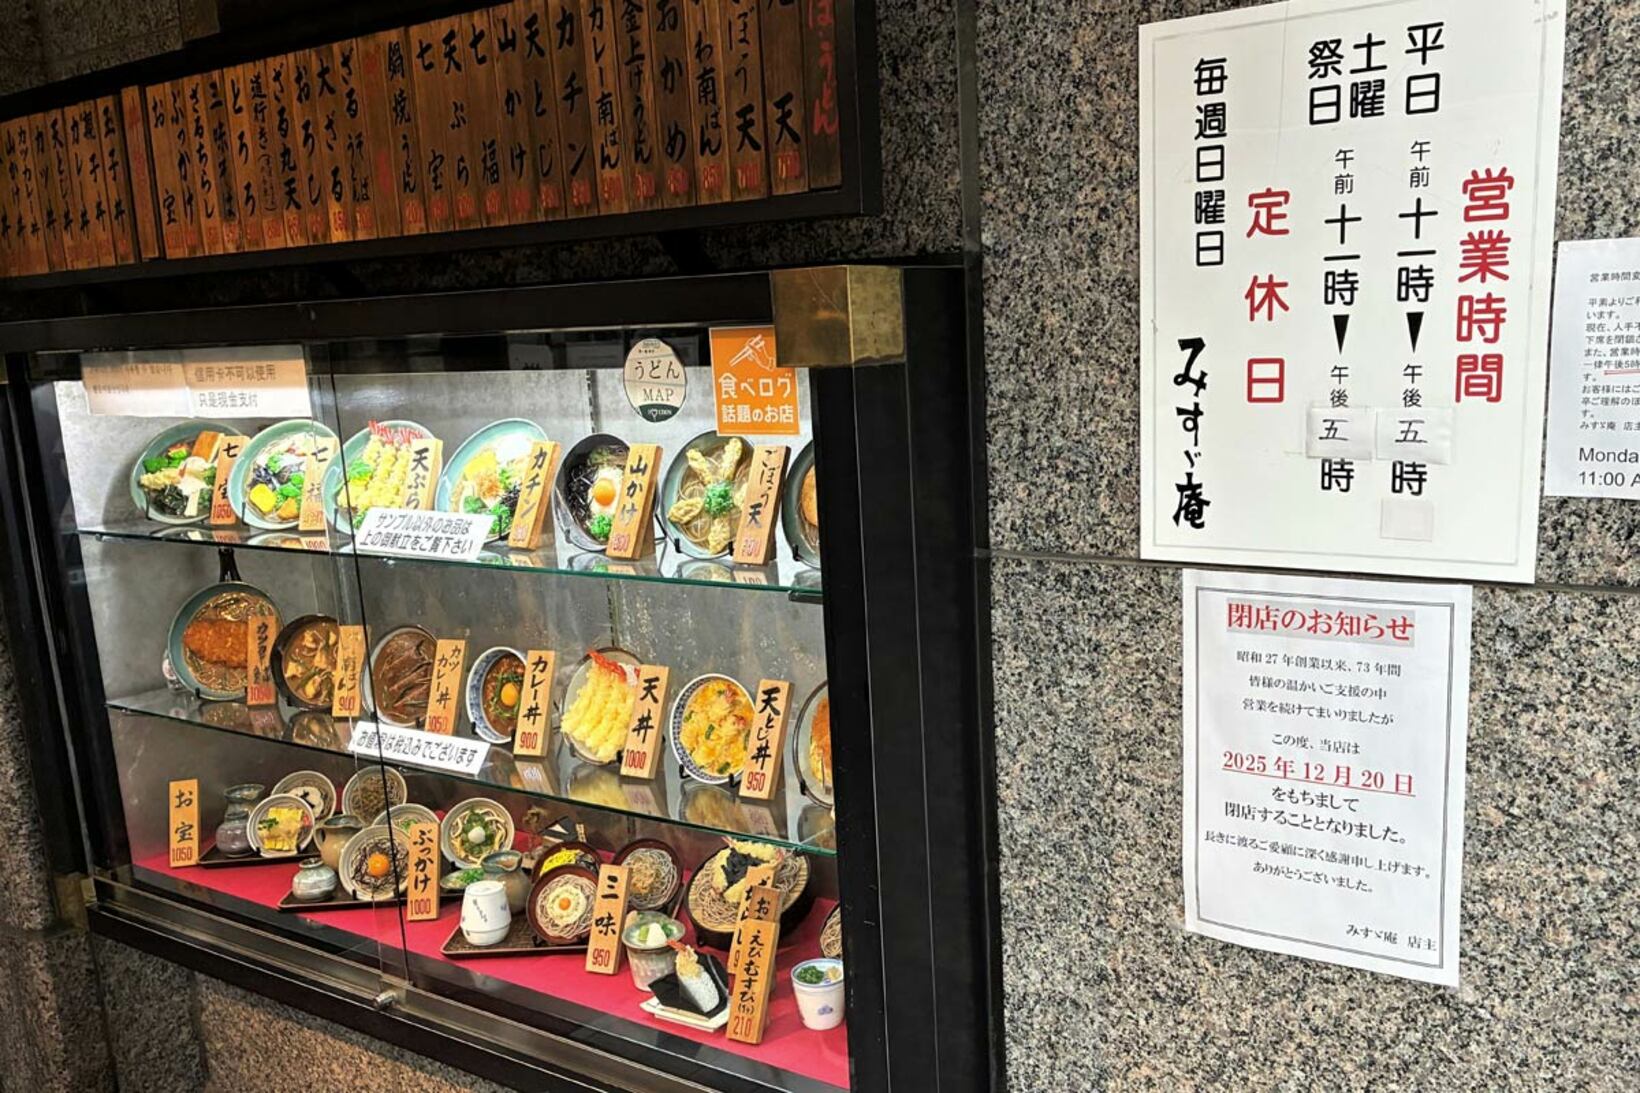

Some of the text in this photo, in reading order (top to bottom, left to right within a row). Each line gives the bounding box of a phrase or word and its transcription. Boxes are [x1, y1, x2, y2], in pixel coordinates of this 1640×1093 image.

[498, 18, 526, 180] 山かけ
[524, 13, 554, 178] 天とじ
[556, 6, 588, 177] カチン
[656, 0, 687, 163] おかめ
[729, 0, 762, 153] ぼう天
[1350, 32, 1388, 119] 土曜
[294, 65, 322, 206] おろし
[316, 58, 344, 203] 大ざる
[1193, 57, 1229, 267] 毎週日曜日
[1308, 38, 1362, 493] 祭日 午前十一時 午後五時
[1391, 21, 1446, 497] 平日 午前十一時 午後五時
[1455, 166, 1515, 403] 営業時間
[1246, 187, 1291, 403] 定休日
[634, 360, 681, 381] うどん
[643, 387, 675, 403] MAP
[718, 371, 794, 401] 食べログ
[721, 404, 795, 429] 話題のお店
[1172, 336, 1212, 530] みすゞ庵
[405, 447, 431, 511] 天ぷら
[520, 447, 548, 519] カチン
[1579, 447, 1639, 464] Monda
[1579, 471, 1625, 487] 11:00
[621, 454, 649, 527] 山かけ
[747, 449, 781, 530] ごぼう天
[1227, 602, 1416, 642] 閉店のお知らせ
[521, 654, 549, 727] カレー丼
[1236, 650, 1262, 665] 昭和
[1265, 653, 1279, 666] 27
[1356, 661, 1372, 675] 73
[1374, 664, 1403, 679] 年間
[1249, 674, 1388, 700] 皆様の温かいご支援の中
[631, 675, 661, 745] 天丼
[751, 686, 783, 777] 天とじ丼
[1241, 697, 1395, 727] 営業を続けてまいりましたが
[518, 735, 538, 751] 900
[624, 751, 647, 771] 1000
[1272, 733, 1362, 755] この度、当店は
[746, 776, 767, 794] 950
[1223, 749, 1414, 796] 2025 年 12 月 20 日
[1271, 785, 1361, 813] をもちまして
[173, 788, 194, 845] お宝
[1224, 801, 1407, 846] 閉店することとなりました。
[171, 847, 194, 864] 1050
[412, 832, 436, 896] ぶっかけ
[1204, 829, 1431, 879] 長きに渡るご愛顧に深く感謝申し上げます。
[1252, 863, 1374, 893] ありがとうございました。
[409, 898, 432, 917] 1000
[593, 874, 621, 938] 三味
[590, 948, 612, 970] 950
[741, 929, 765, 1003] えびむすび
[1407, 935, 1439, 952] 店主
[732, 1015, 754, 1038] 210
